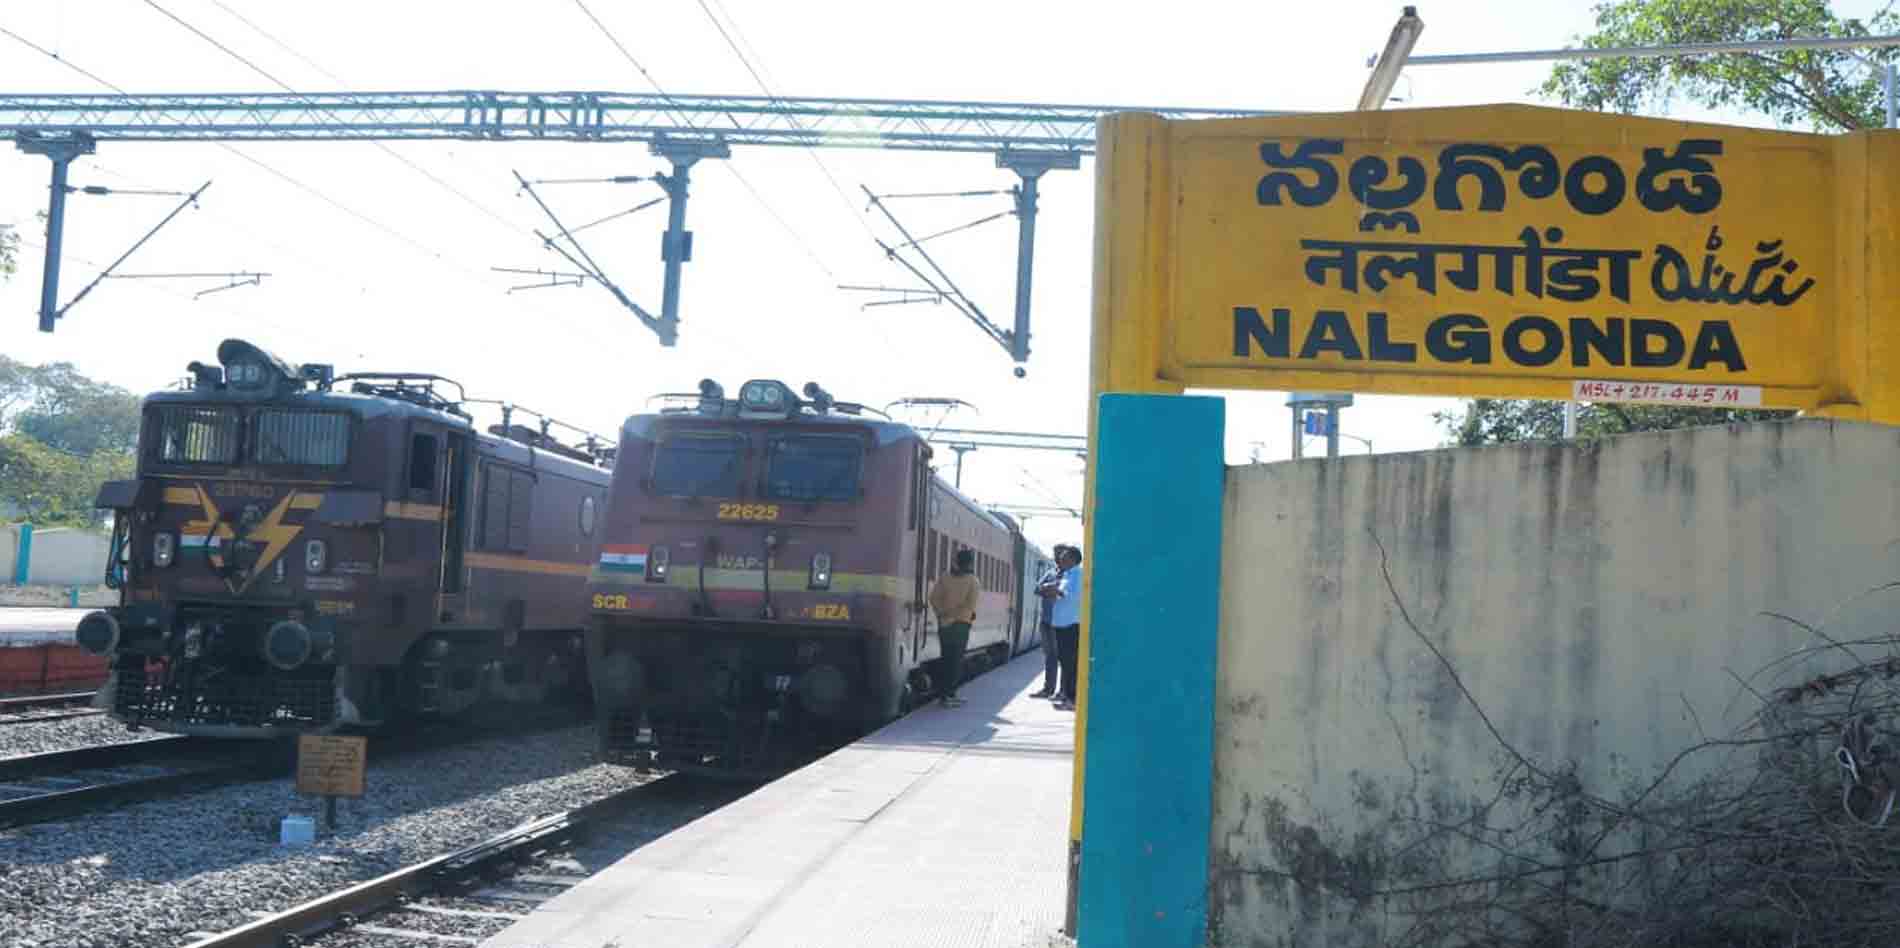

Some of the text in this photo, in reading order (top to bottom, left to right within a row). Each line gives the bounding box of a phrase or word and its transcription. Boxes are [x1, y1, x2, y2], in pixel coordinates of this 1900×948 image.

[1257, 138, 1723, 233] నల్లగొండ
[1301, 226, 1642, 303] नलगोंडा
[1233, 307, 1747, 372] NALGONDA
[718, 503, 778, 519] 22625
[592, 593, 630, 609] SCR
